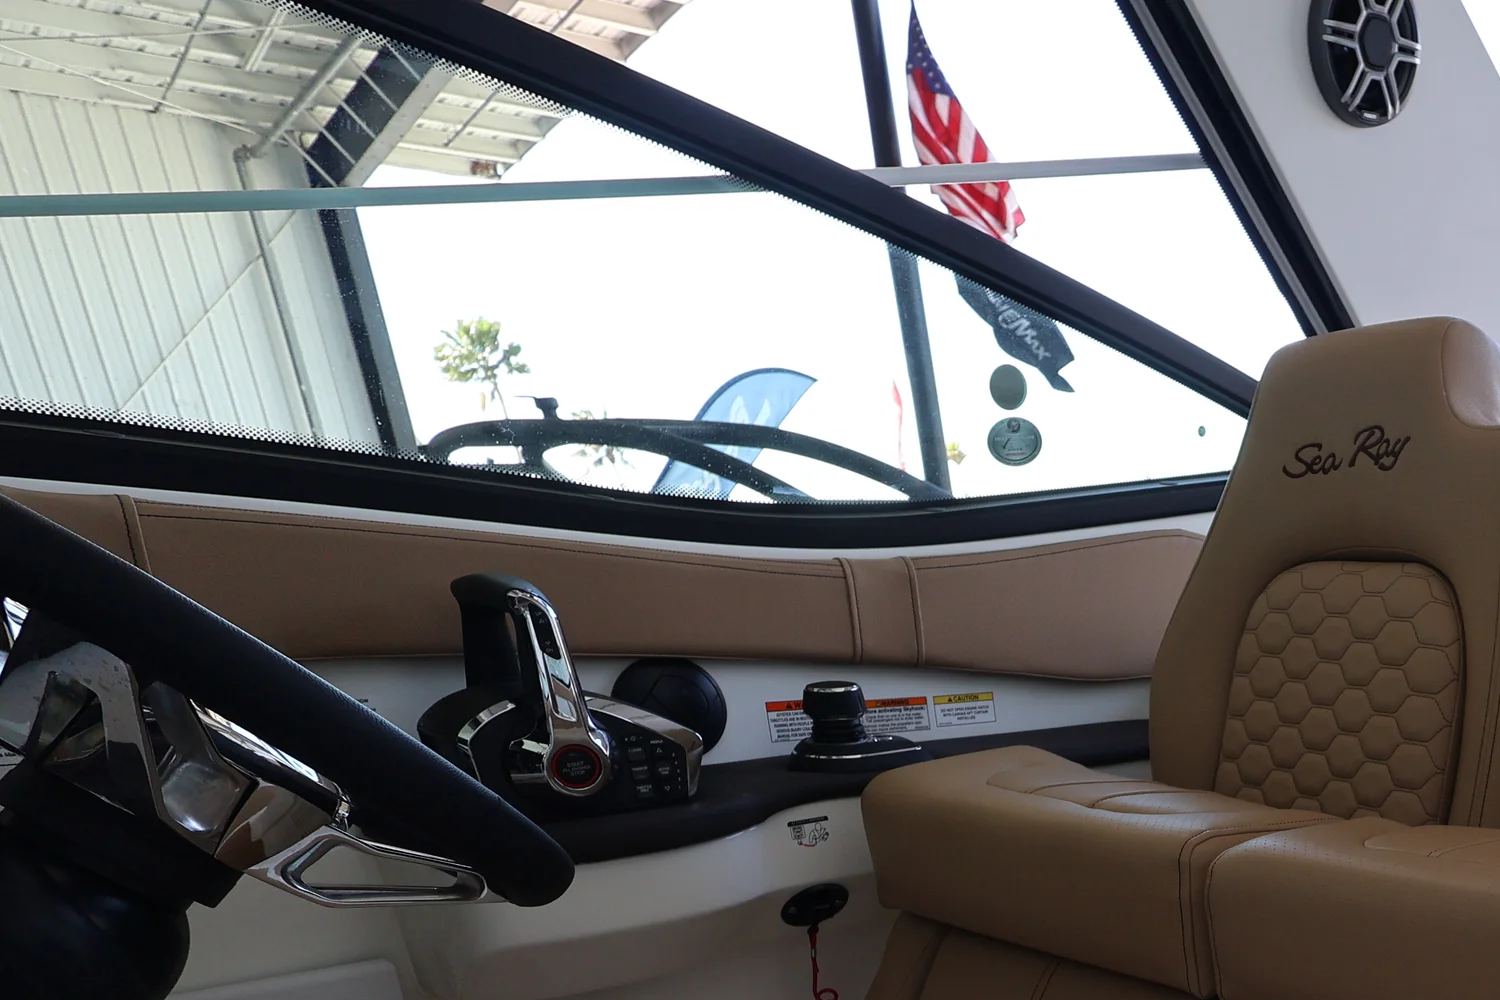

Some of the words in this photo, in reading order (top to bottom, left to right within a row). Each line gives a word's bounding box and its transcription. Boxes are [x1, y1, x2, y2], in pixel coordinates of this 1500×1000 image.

[1282, 442, 1343, 479] Sea
[1348, 425, 1411, 472] Ray
[953, 694, 979, 702] CAUTION
